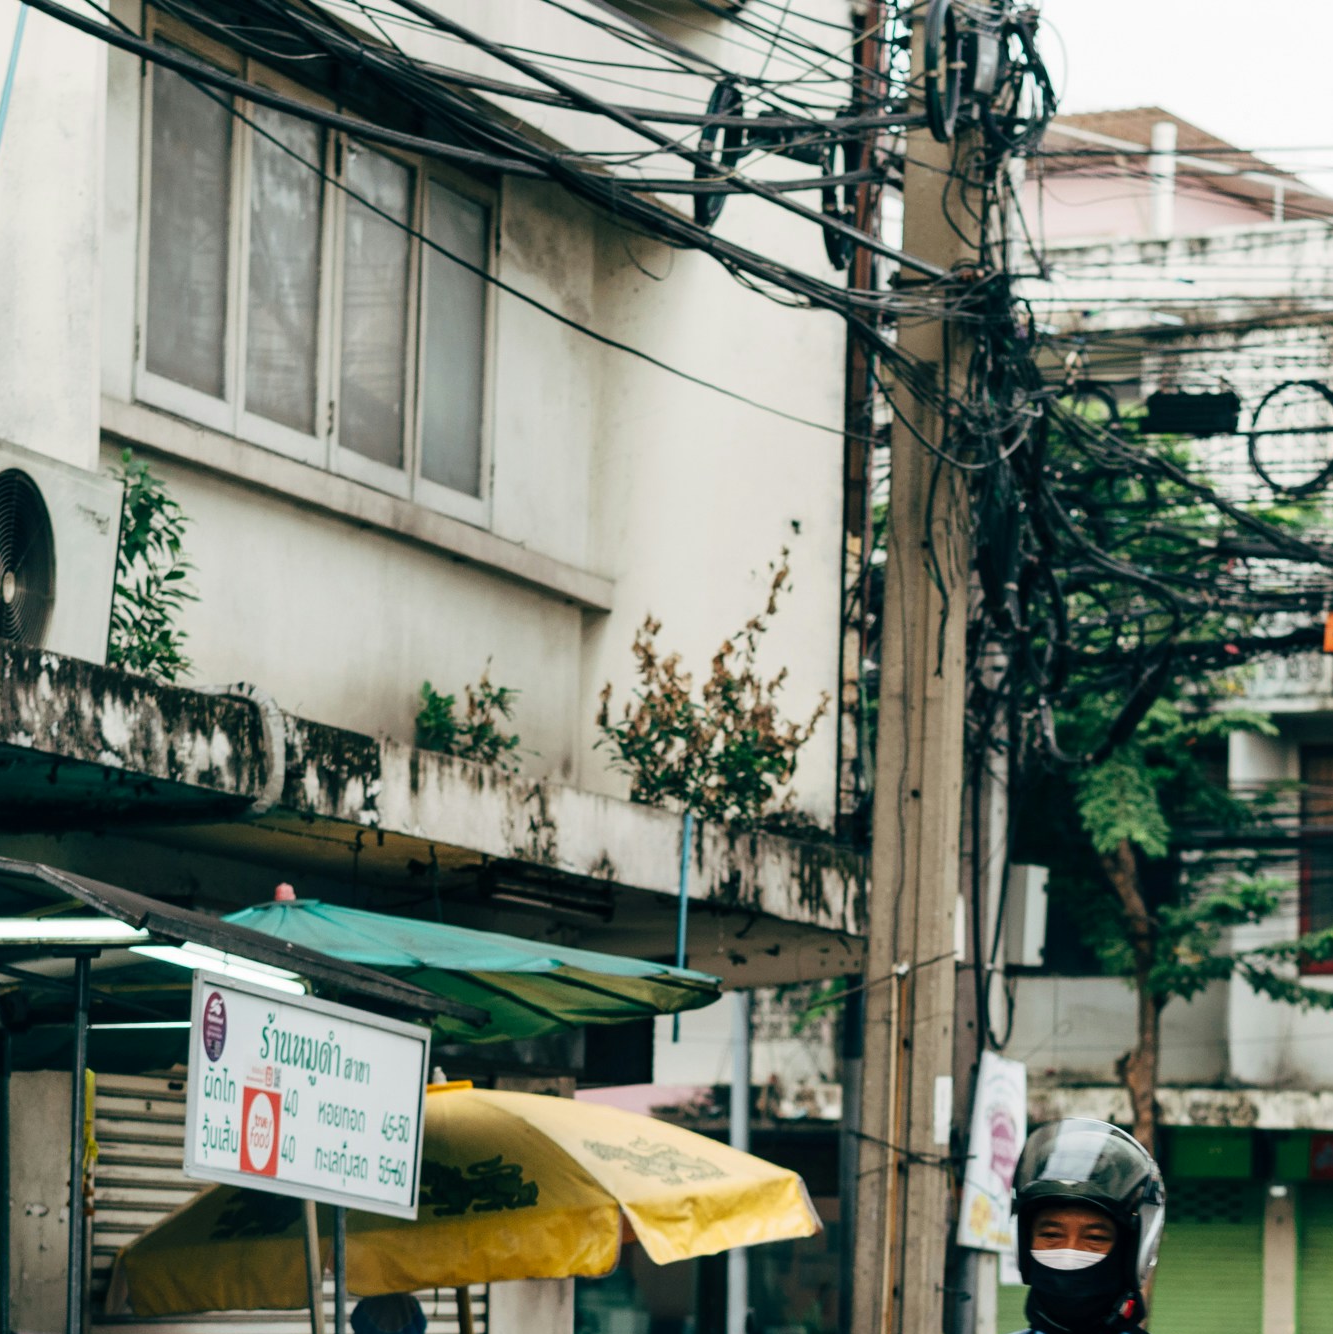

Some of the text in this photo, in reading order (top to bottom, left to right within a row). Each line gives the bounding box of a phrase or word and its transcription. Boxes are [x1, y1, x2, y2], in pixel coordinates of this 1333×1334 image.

[260, 1013, 341, 1086] ร้านหมูดำ
[344, 1057, 370, 1084] สาขา
[255, 1114, 268, 1128] true
[284, 1087, 298, 1118] 40
[318, 1101, 410, 1143] หอยทอด 45-50
[202, 1113, 296, 1164] วุ้นเส้น 40
[249, 1120, 271, 1149] food
[315, 1141, 407, 1187] ทะเลกุ้งสด 55-60
